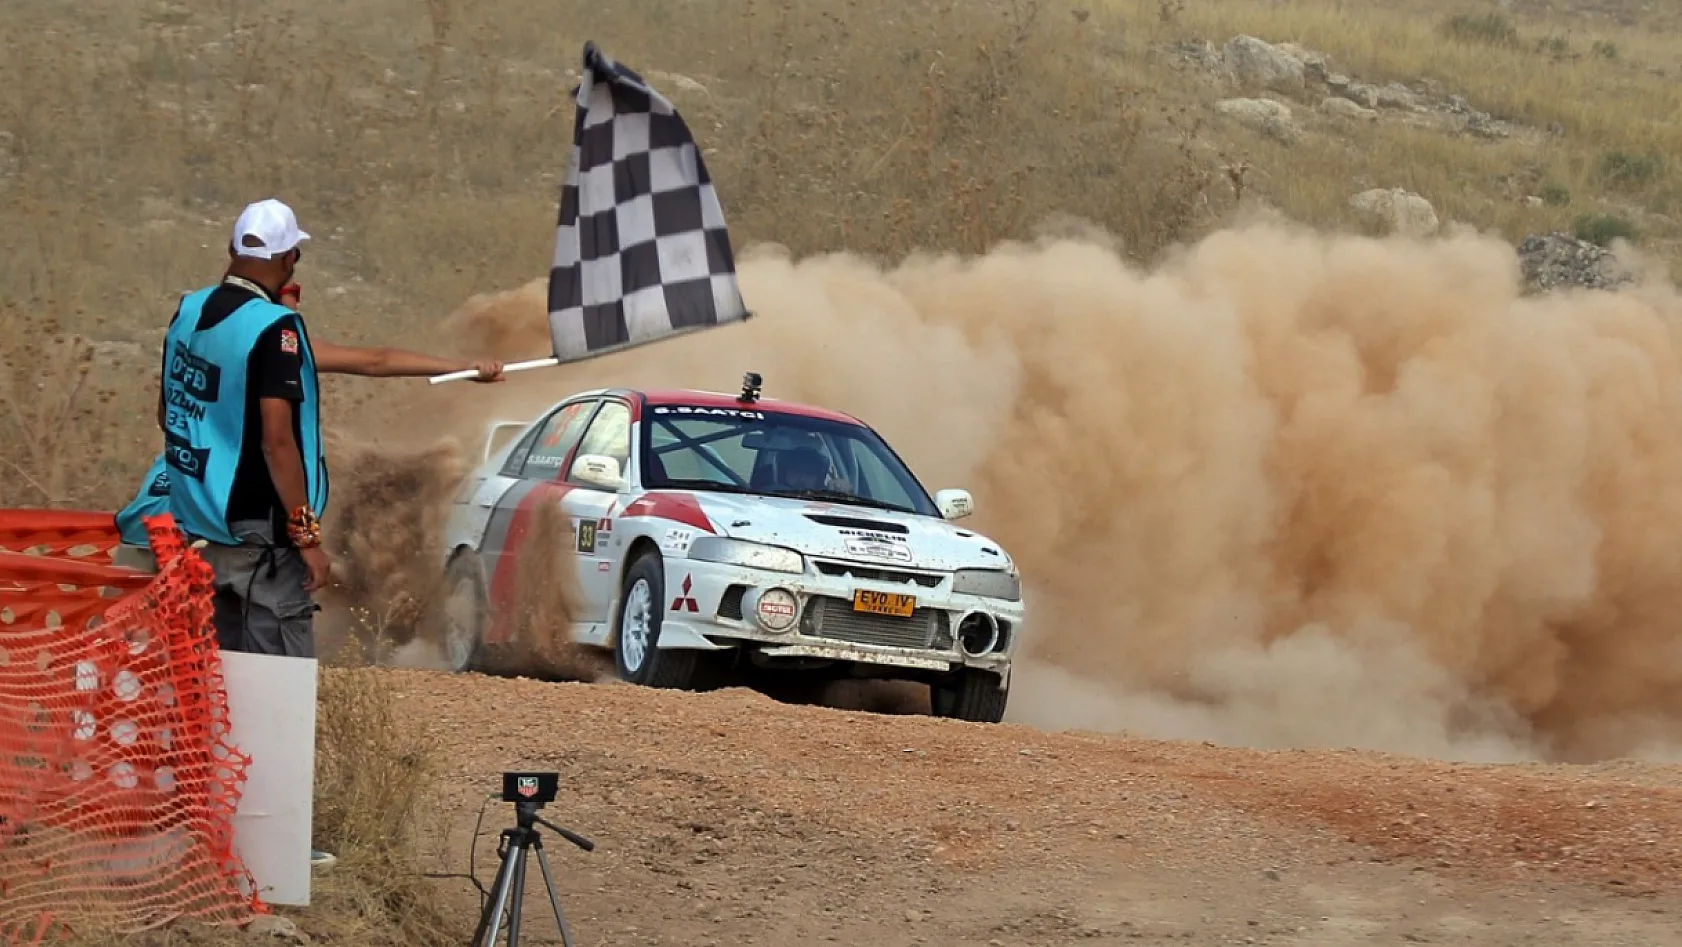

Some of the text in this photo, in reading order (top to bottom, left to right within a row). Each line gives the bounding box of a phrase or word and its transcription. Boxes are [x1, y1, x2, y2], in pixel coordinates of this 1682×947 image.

[838, 529, 907, 542] MICHELIN
[861, 590, 909, 607] EVO IV
